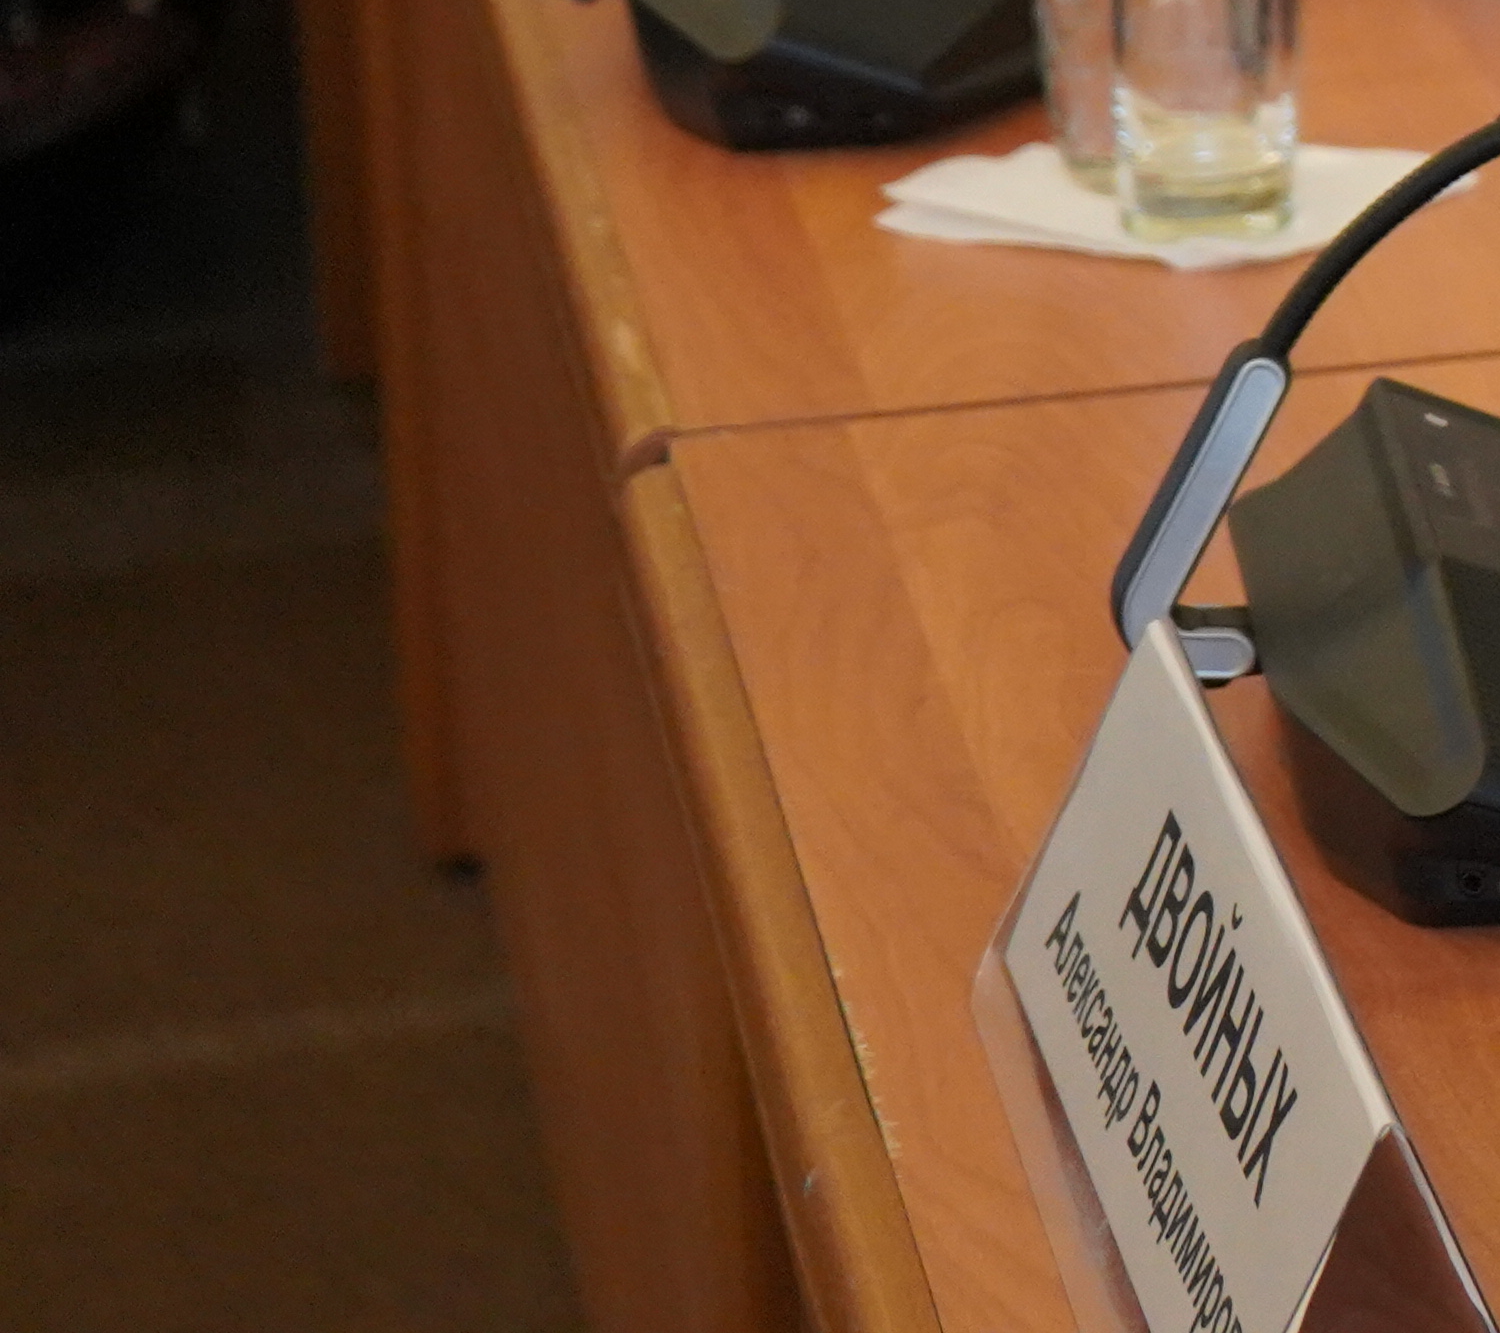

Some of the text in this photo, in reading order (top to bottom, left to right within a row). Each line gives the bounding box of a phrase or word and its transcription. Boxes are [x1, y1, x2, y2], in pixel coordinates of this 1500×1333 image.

[1045, 889, 1243, 1333] Александр Владимиро
[1118, 808, 1298, 1210] ДВОЙНЫХ
